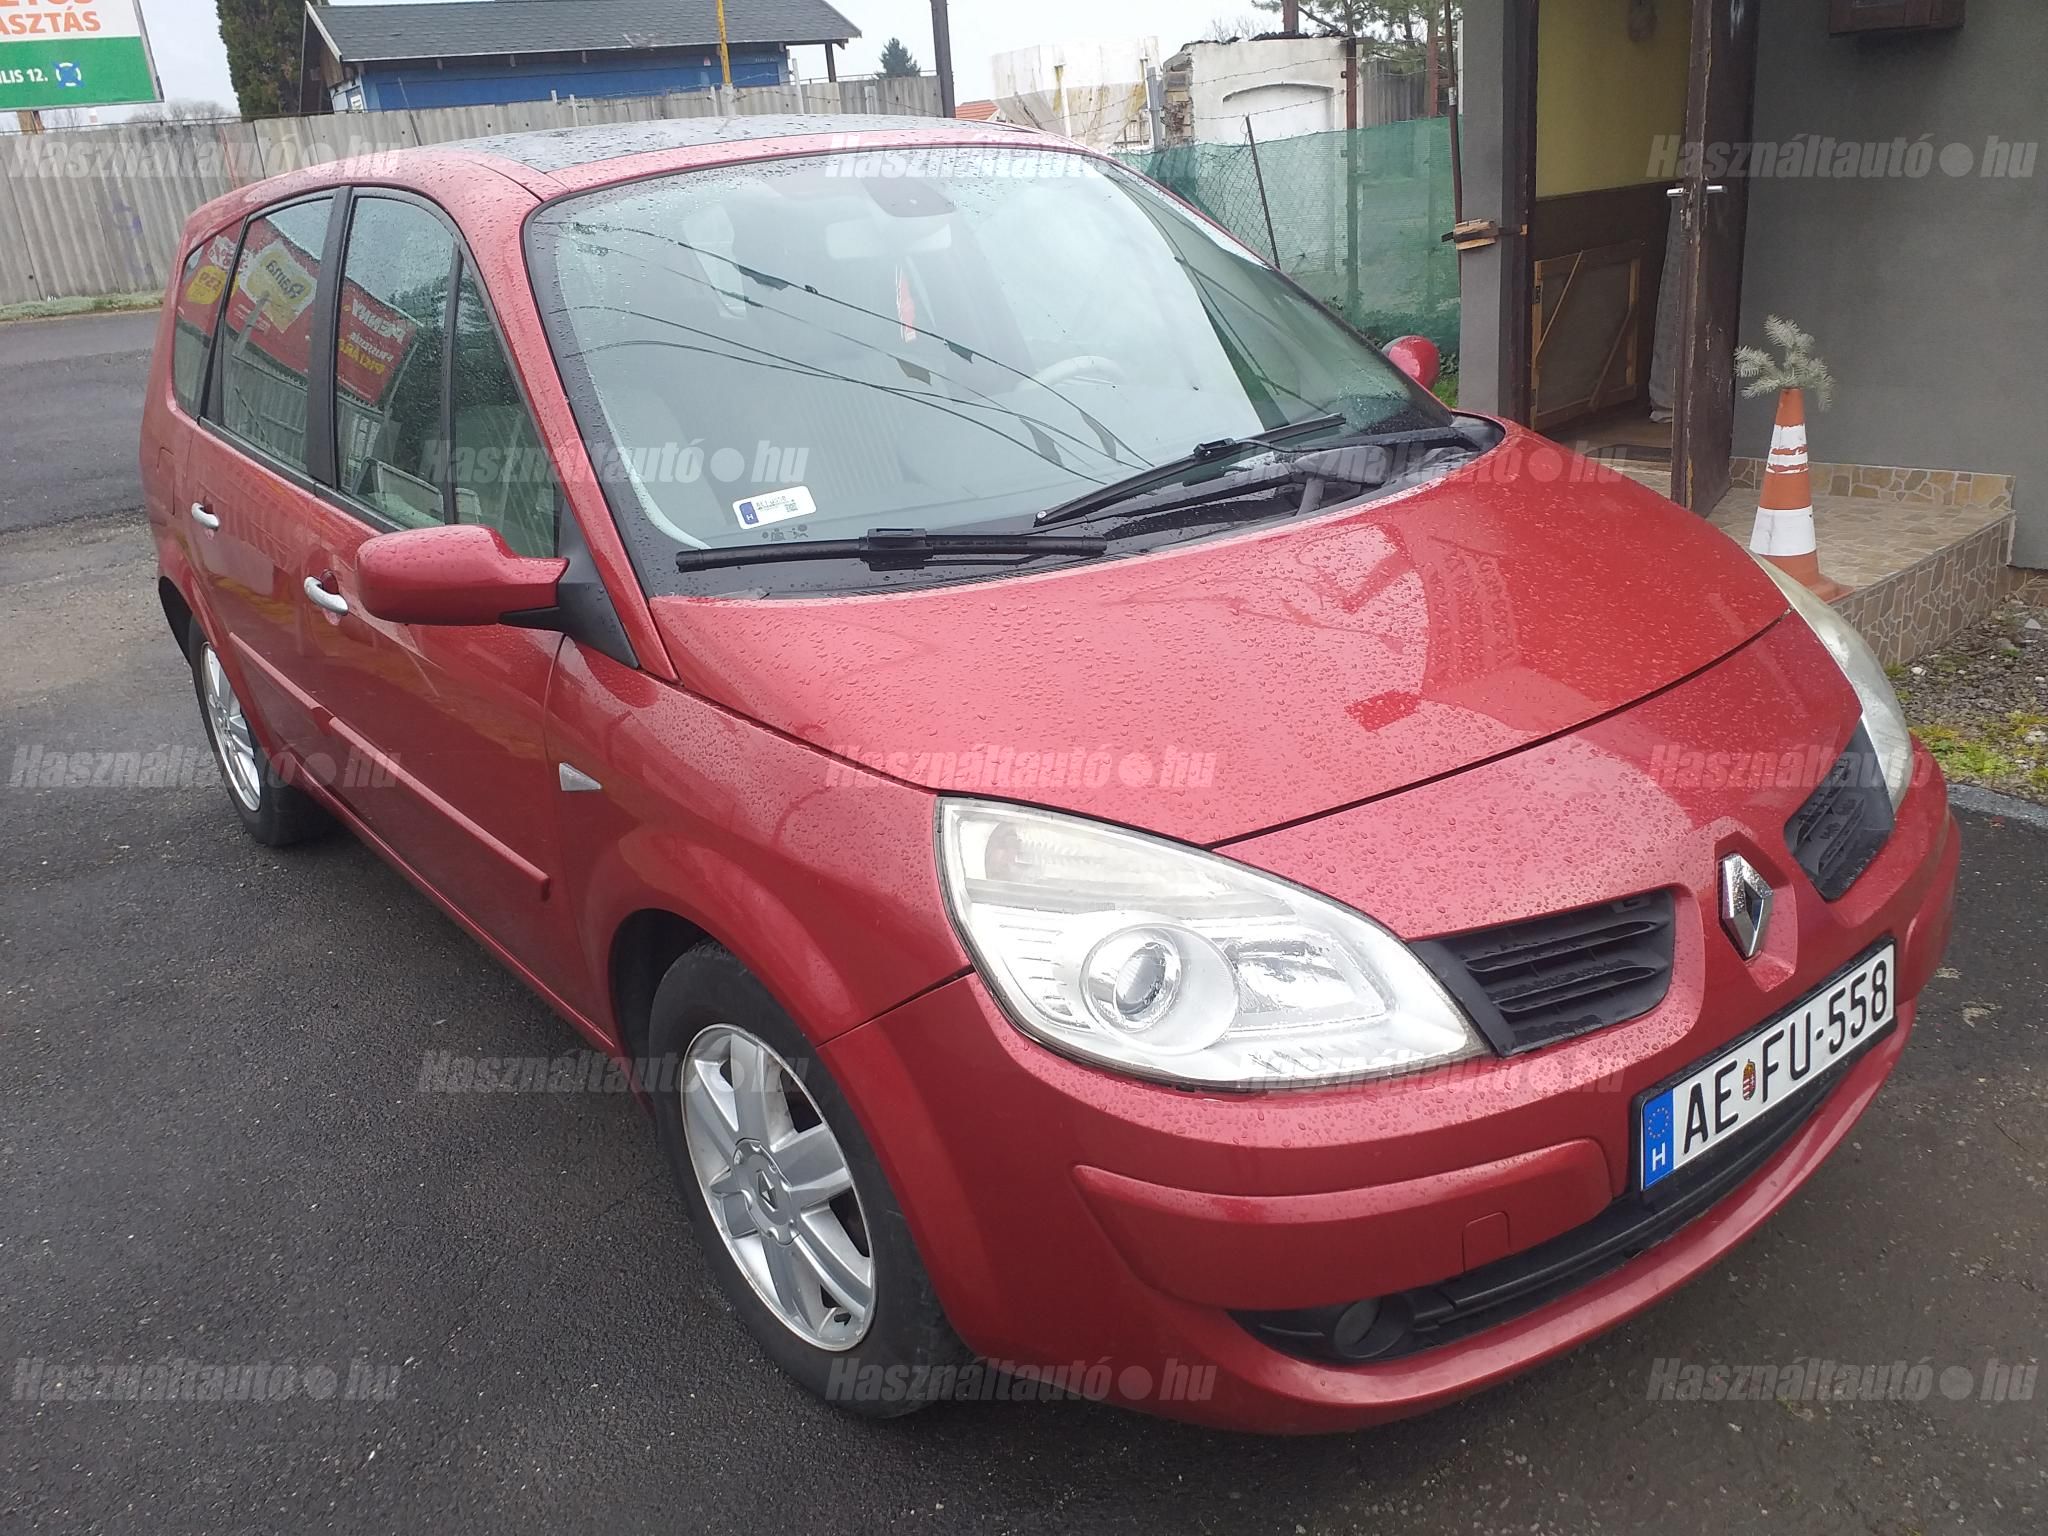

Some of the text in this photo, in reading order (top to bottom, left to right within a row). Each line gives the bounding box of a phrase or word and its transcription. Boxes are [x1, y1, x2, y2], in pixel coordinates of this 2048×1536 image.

[0, 68, 48, 83] LIS 12.
[1683, 1059, 1739, 1155] AE
[1651, 1142, 1667, 1172] H
